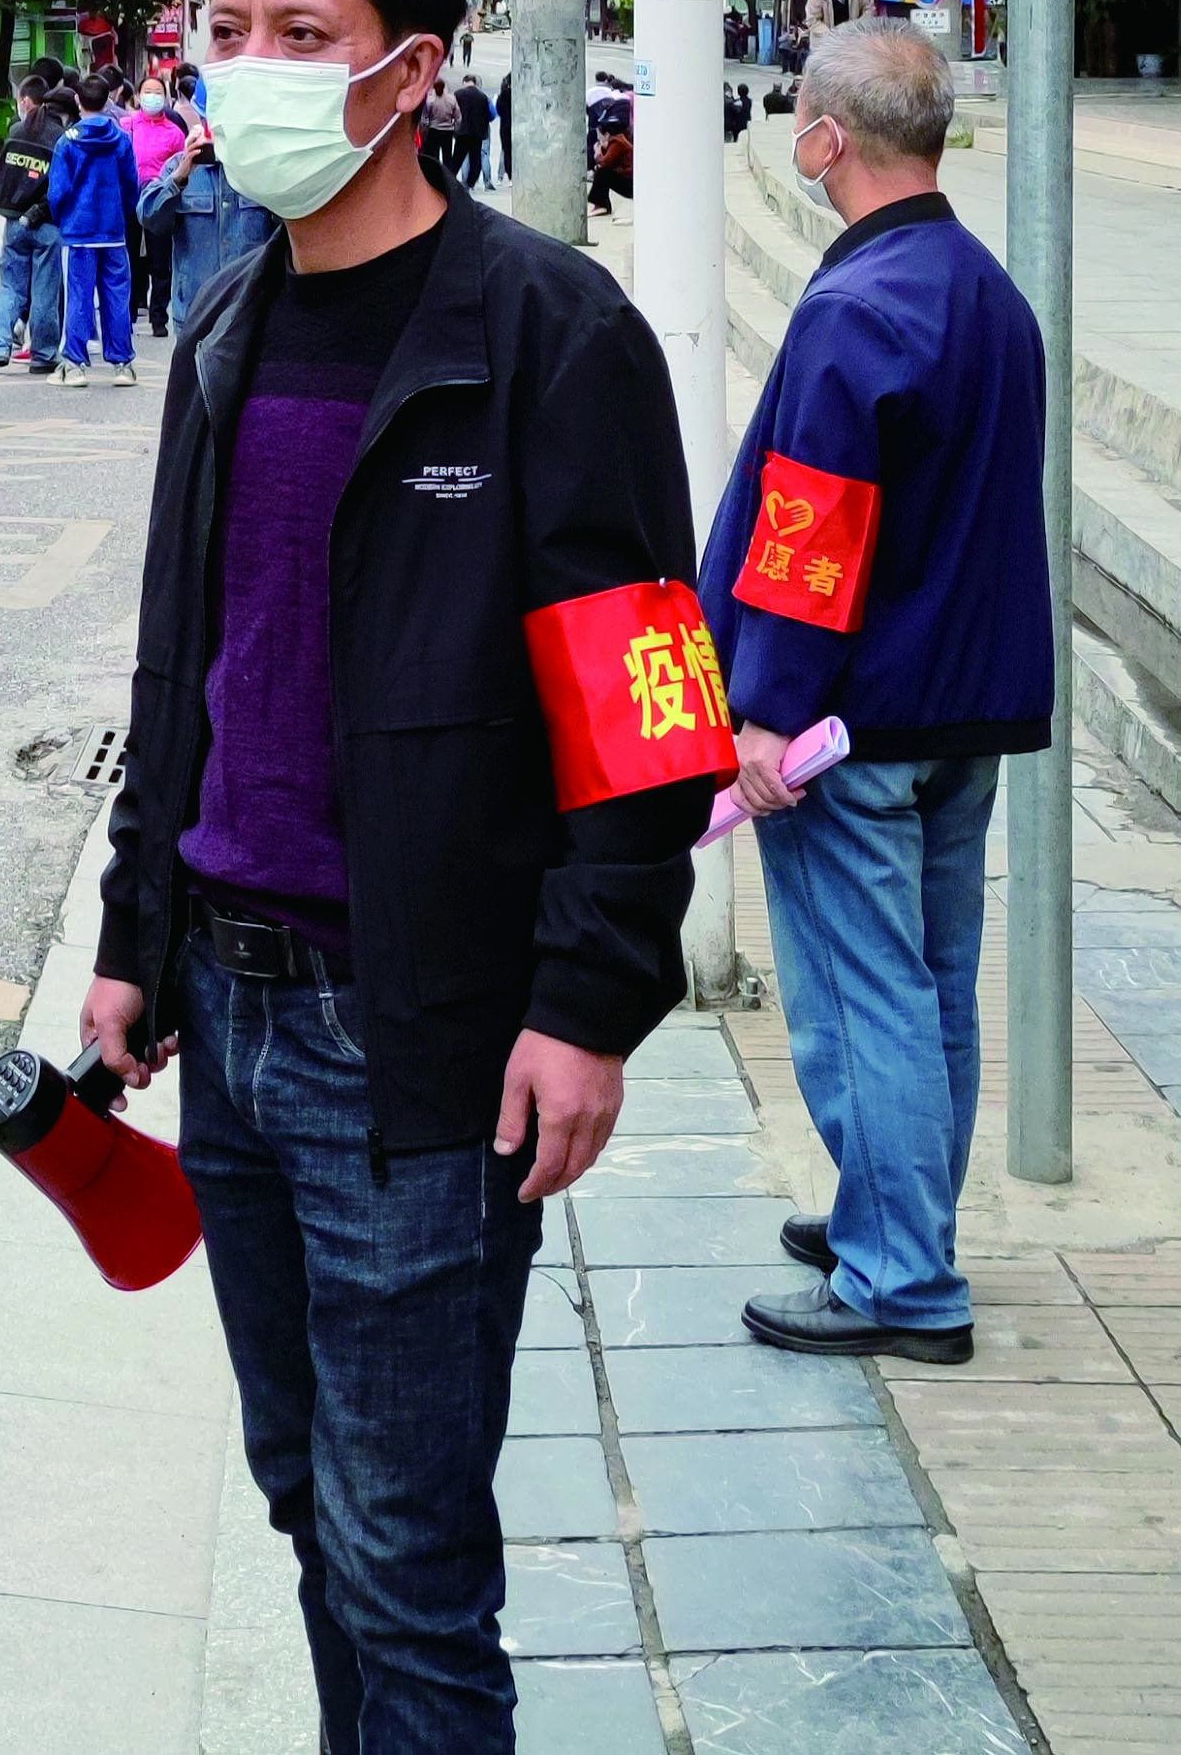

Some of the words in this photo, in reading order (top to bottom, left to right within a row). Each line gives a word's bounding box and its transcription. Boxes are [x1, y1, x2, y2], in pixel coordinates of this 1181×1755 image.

[423, 465, 479, 477] PERFECT
[745, 536, 844, 597] 愿者
[623, 621, 729, 740] 疫情
